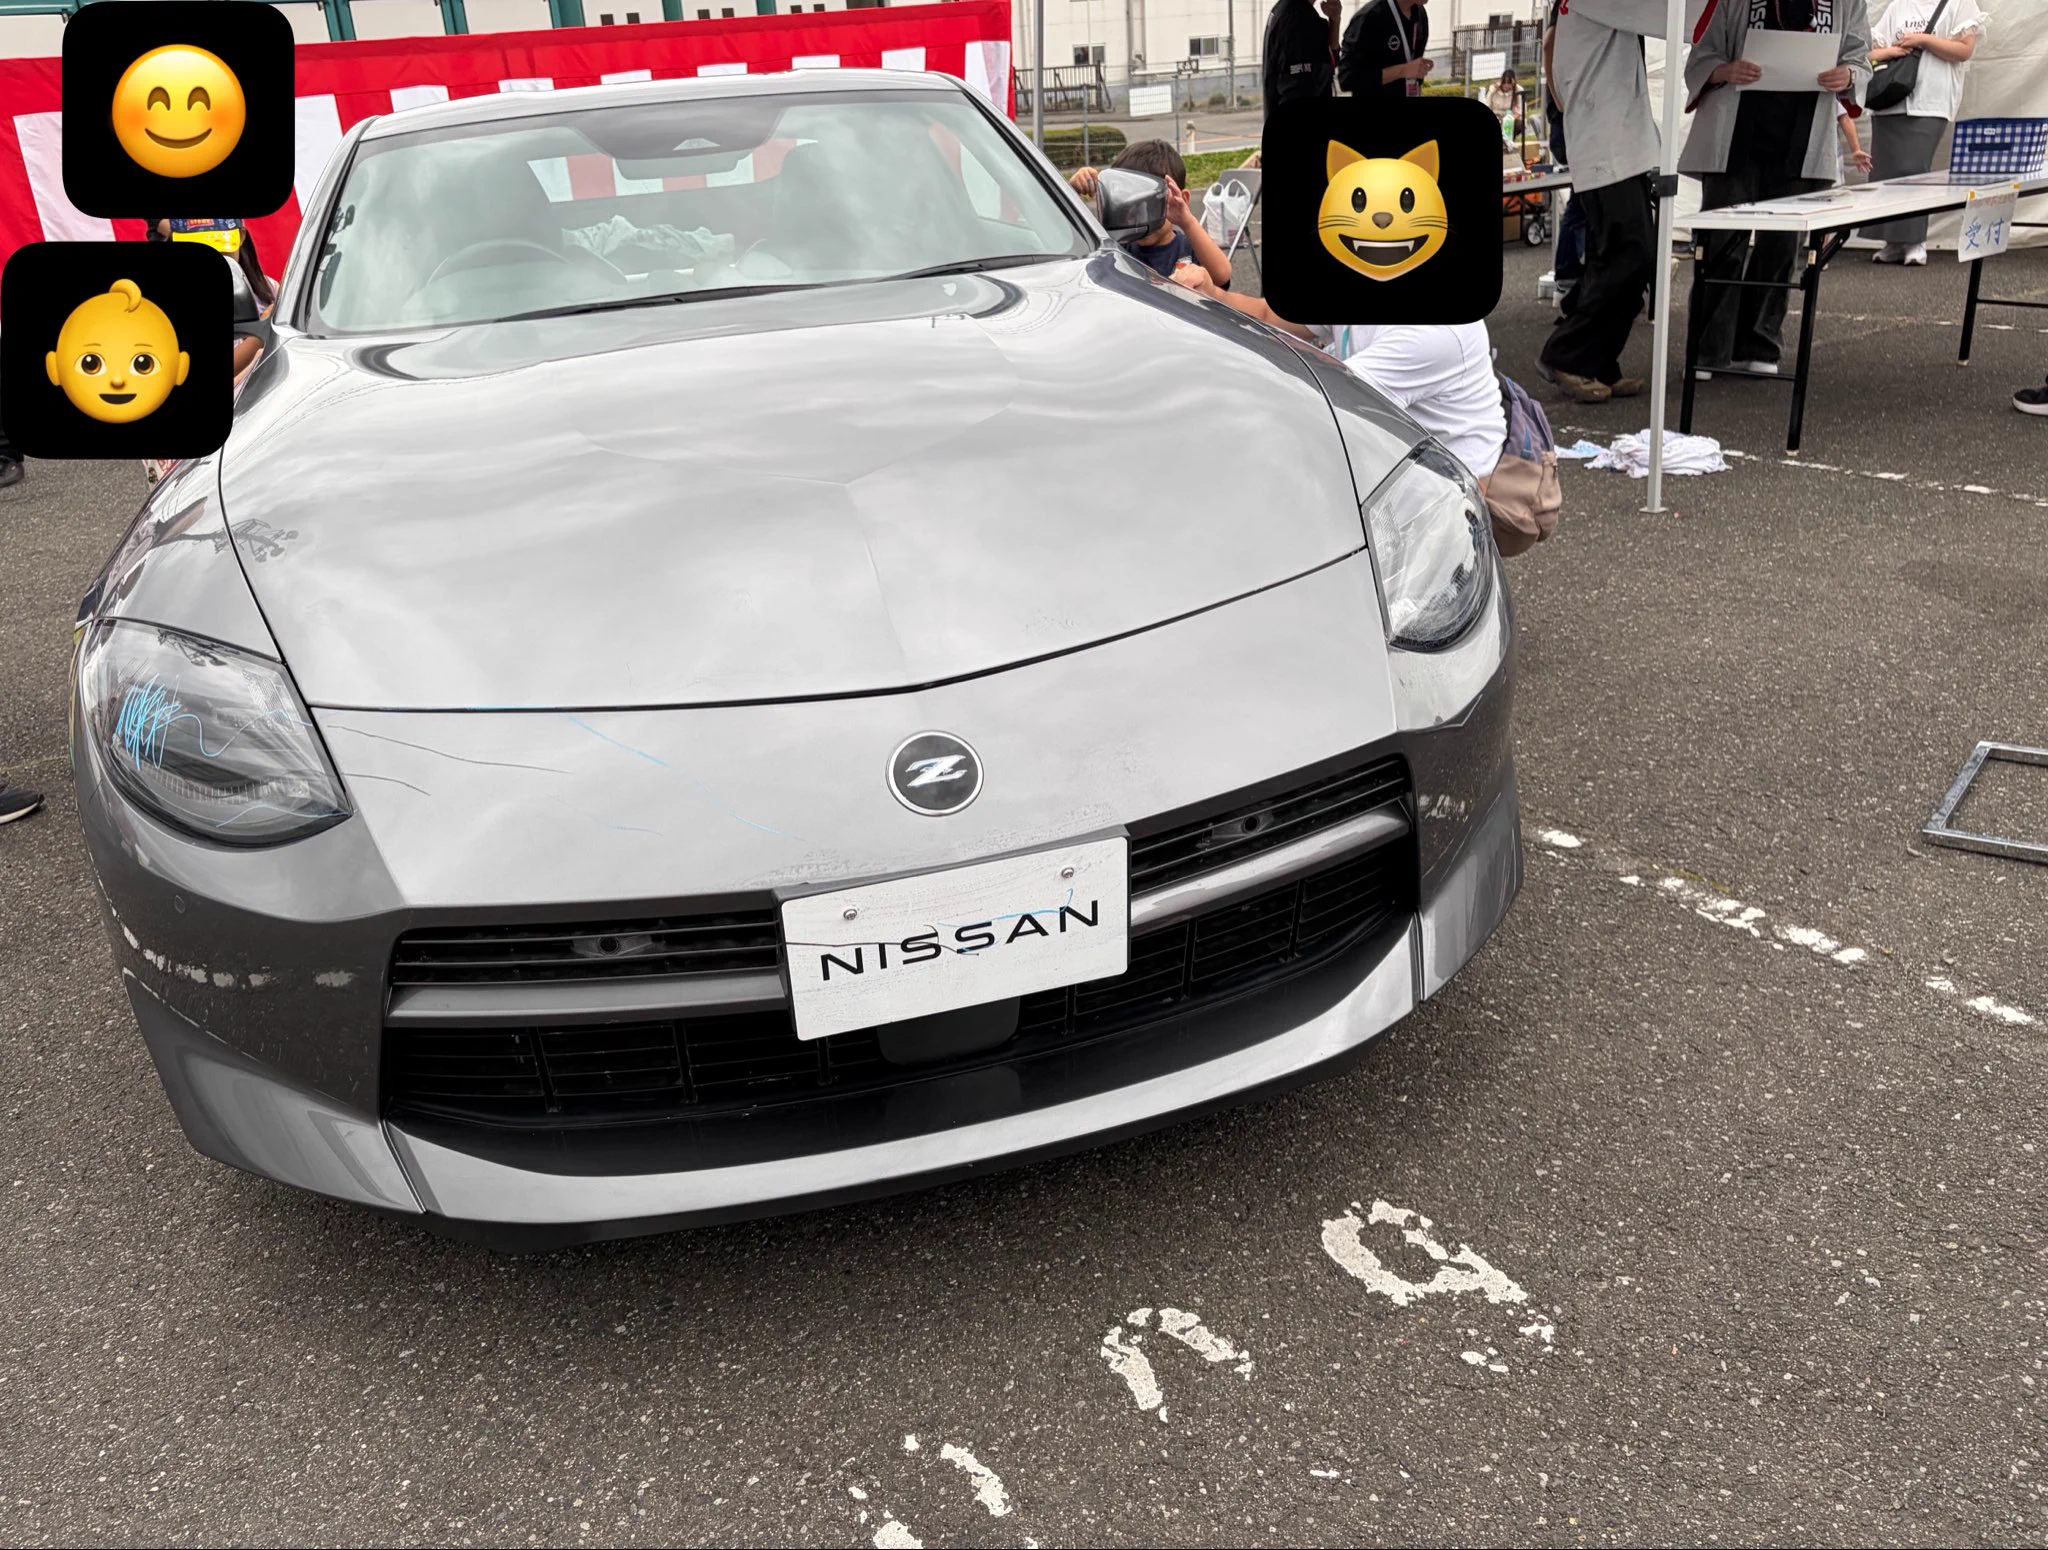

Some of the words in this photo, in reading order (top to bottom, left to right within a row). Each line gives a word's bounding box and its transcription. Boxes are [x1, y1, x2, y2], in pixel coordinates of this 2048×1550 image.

[1749, 0, 1768, 30] ISS
[1965, 216, 2005, 251] 受付
[905, 754, 968, 789] Z
[820, 899, 1099, 981] NISSAN
